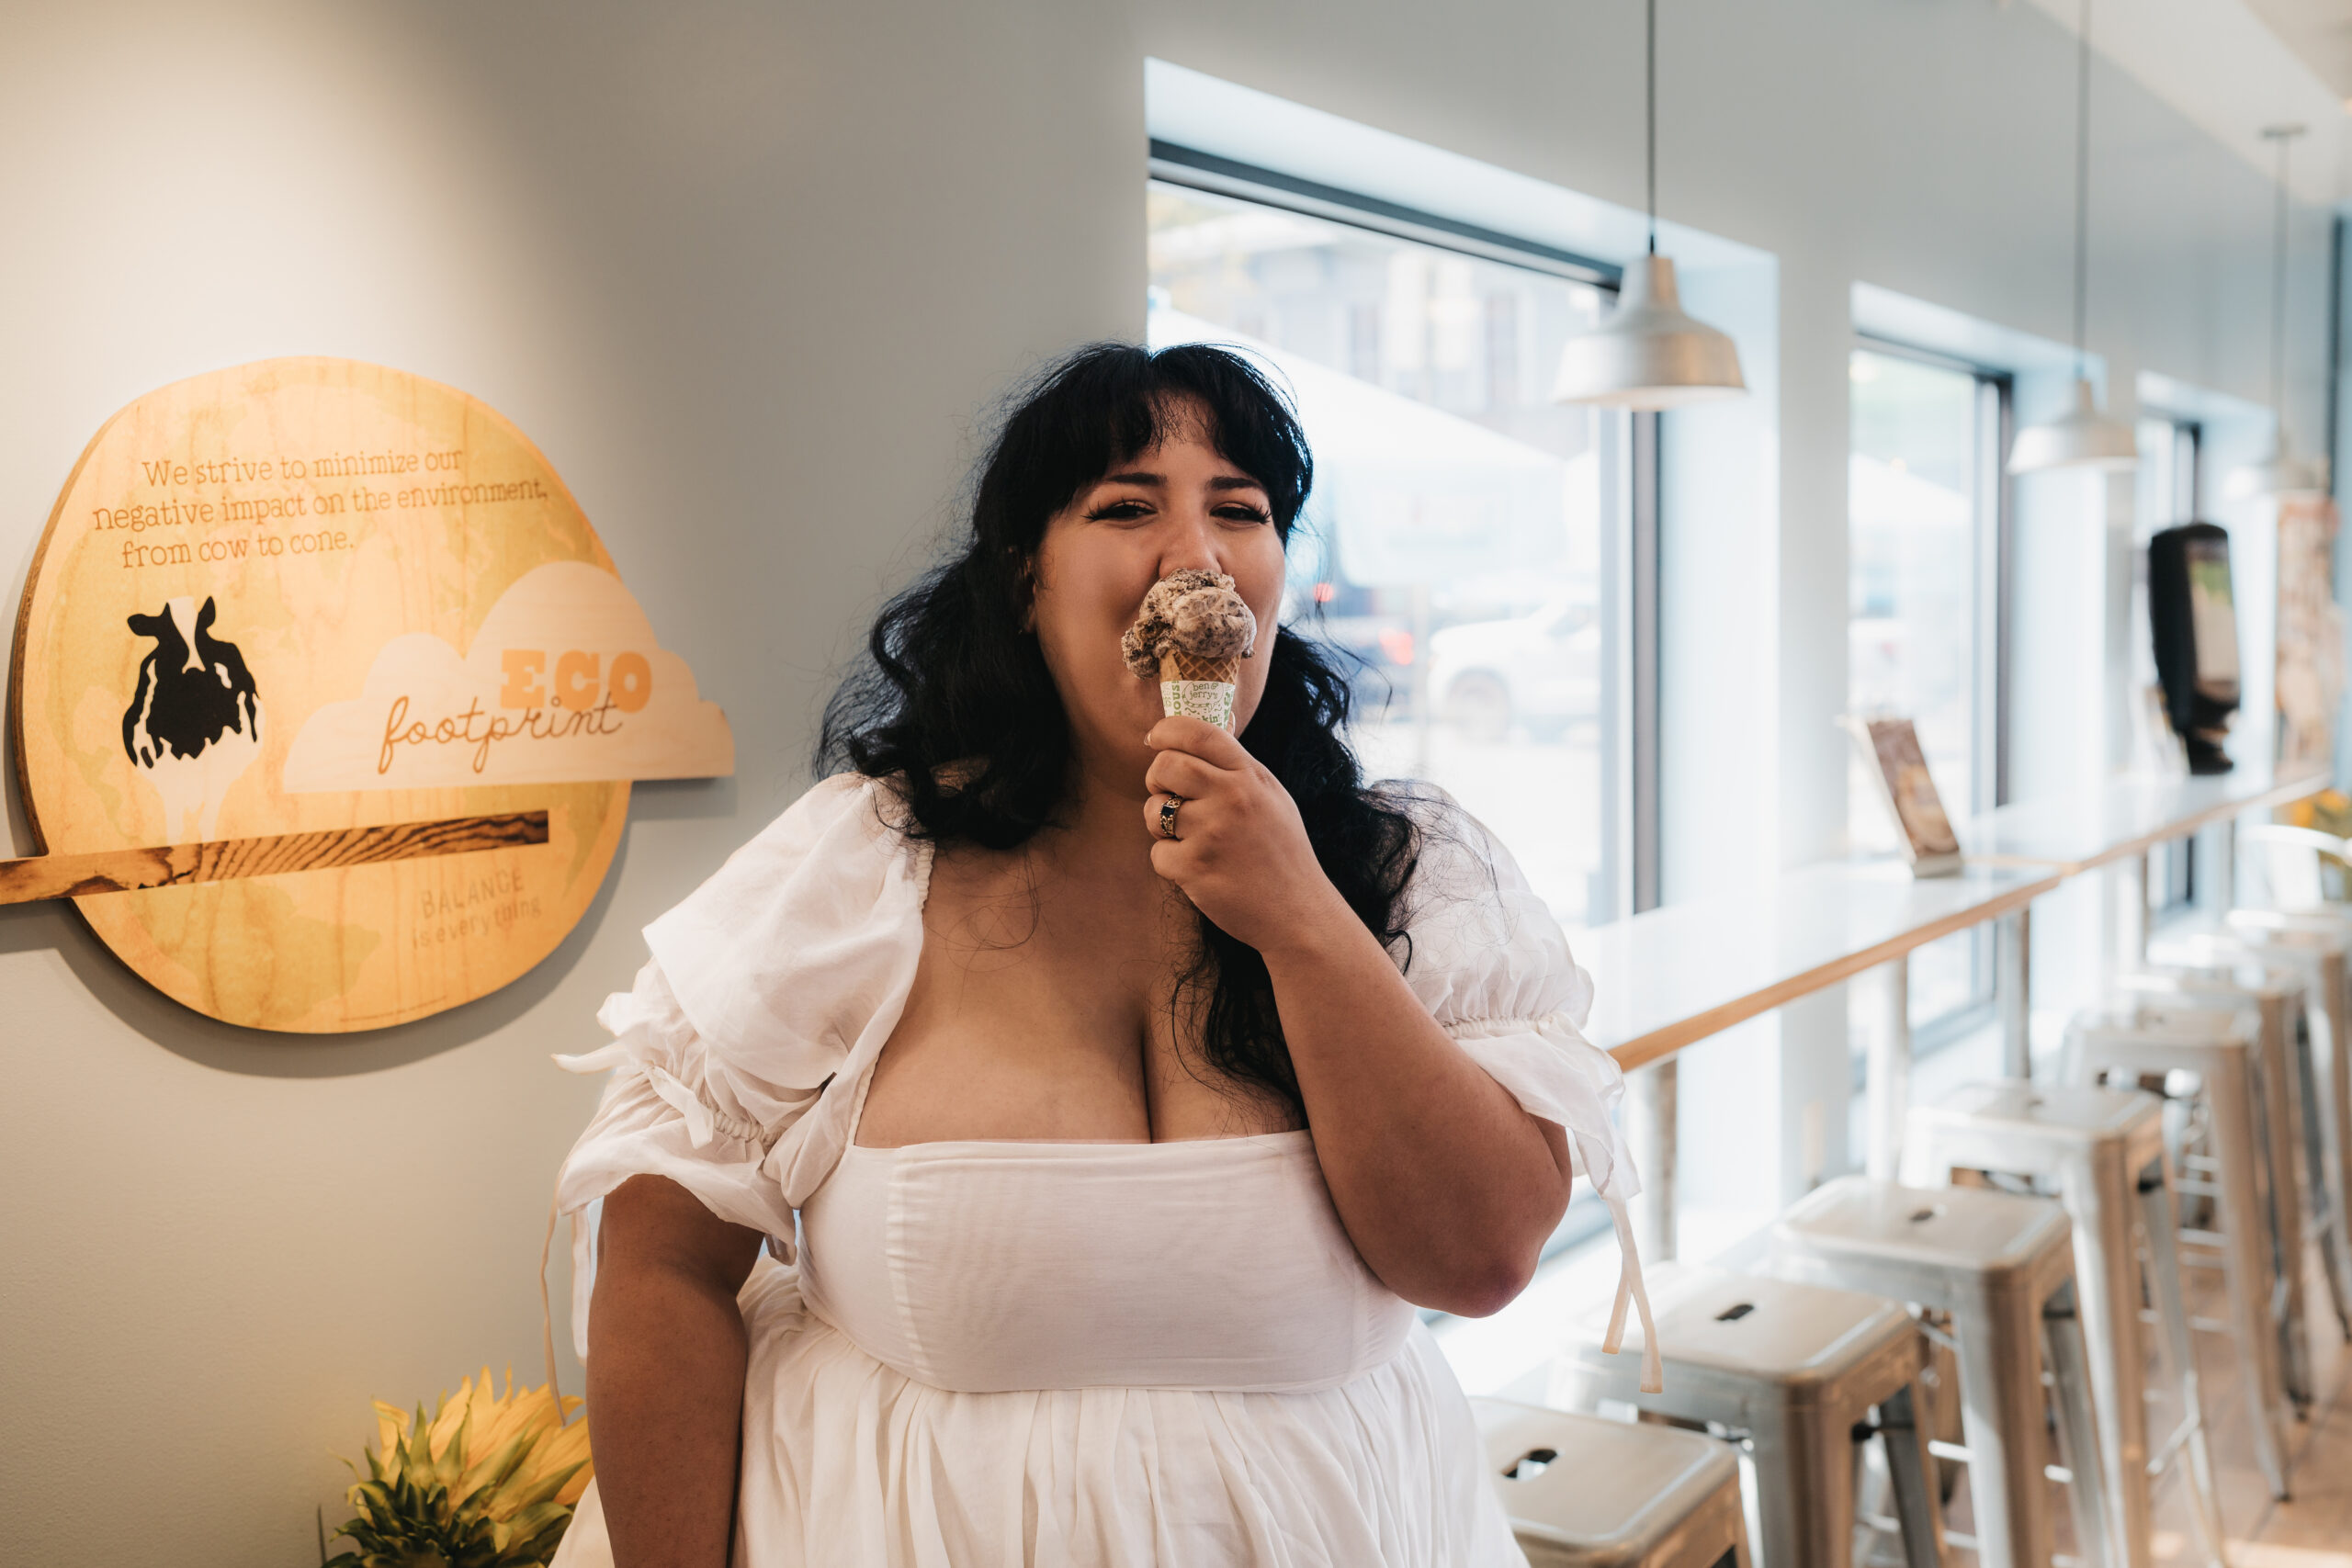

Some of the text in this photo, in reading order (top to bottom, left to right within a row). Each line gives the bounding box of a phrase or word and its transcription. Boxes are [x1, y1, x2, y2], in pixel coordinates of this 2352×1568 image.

[141, 450, 463, 487] We strive to minimize our
[92, 478, 548, 533] negative impact on the environment,
[122, 530, 355, 569] from cow to cone.
[500, 649, 652, 714] ECO
[1192, 682, 1210, 692] ben
[378, 691, 623, 774] footprint
[421, 867, 525, 919] BALANCE
